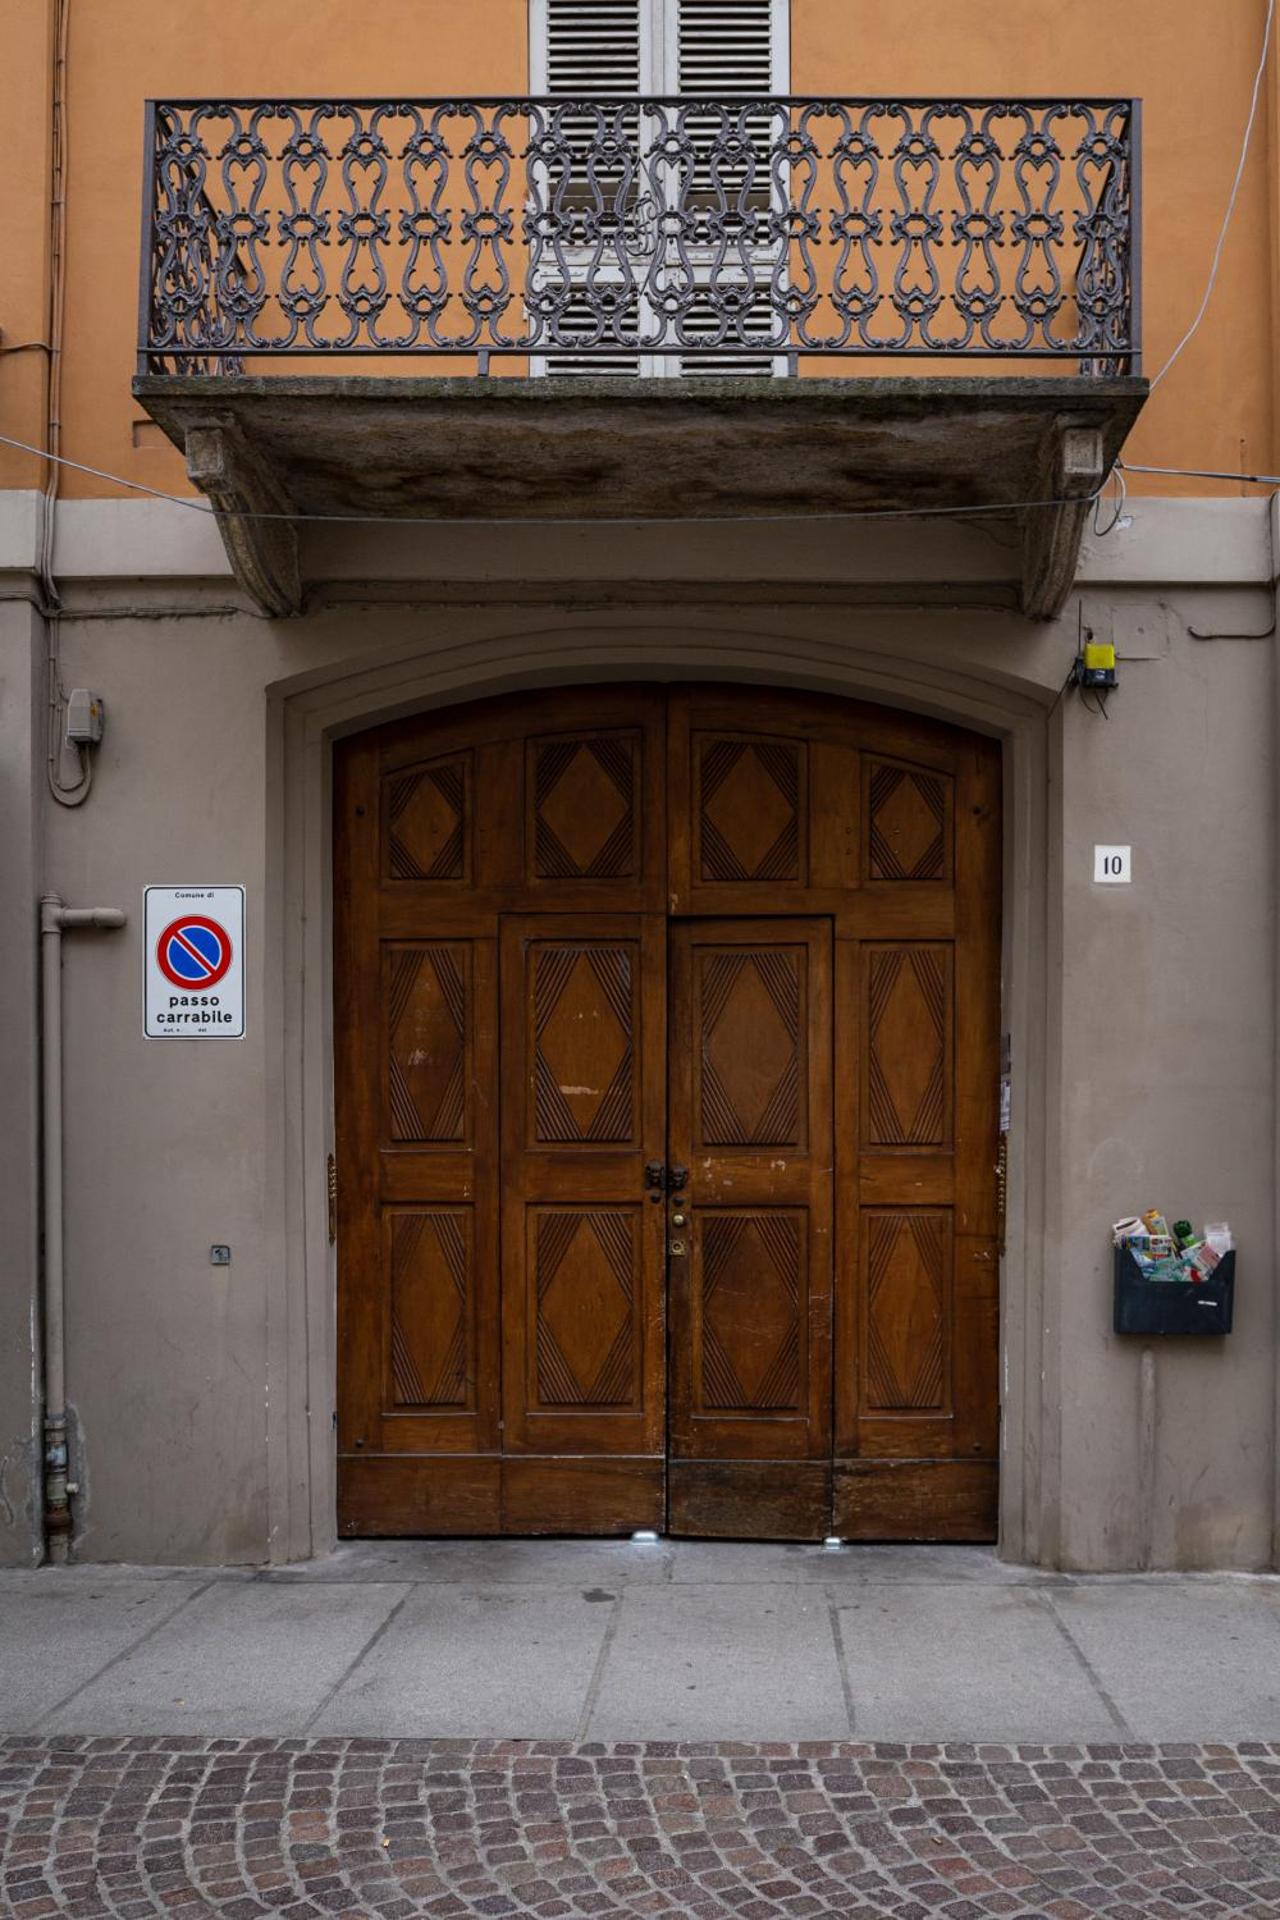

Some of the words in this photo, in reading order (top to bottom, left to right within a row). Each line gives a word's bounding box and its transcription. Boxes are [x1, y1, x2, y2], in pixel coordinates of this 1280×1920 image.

[1104, 855, 1122, 875] 10
[174, 891, 204, 899] Comune
[169, 996, 220, 1008] passo
[156, 1010, 233, 1023] carrabile
